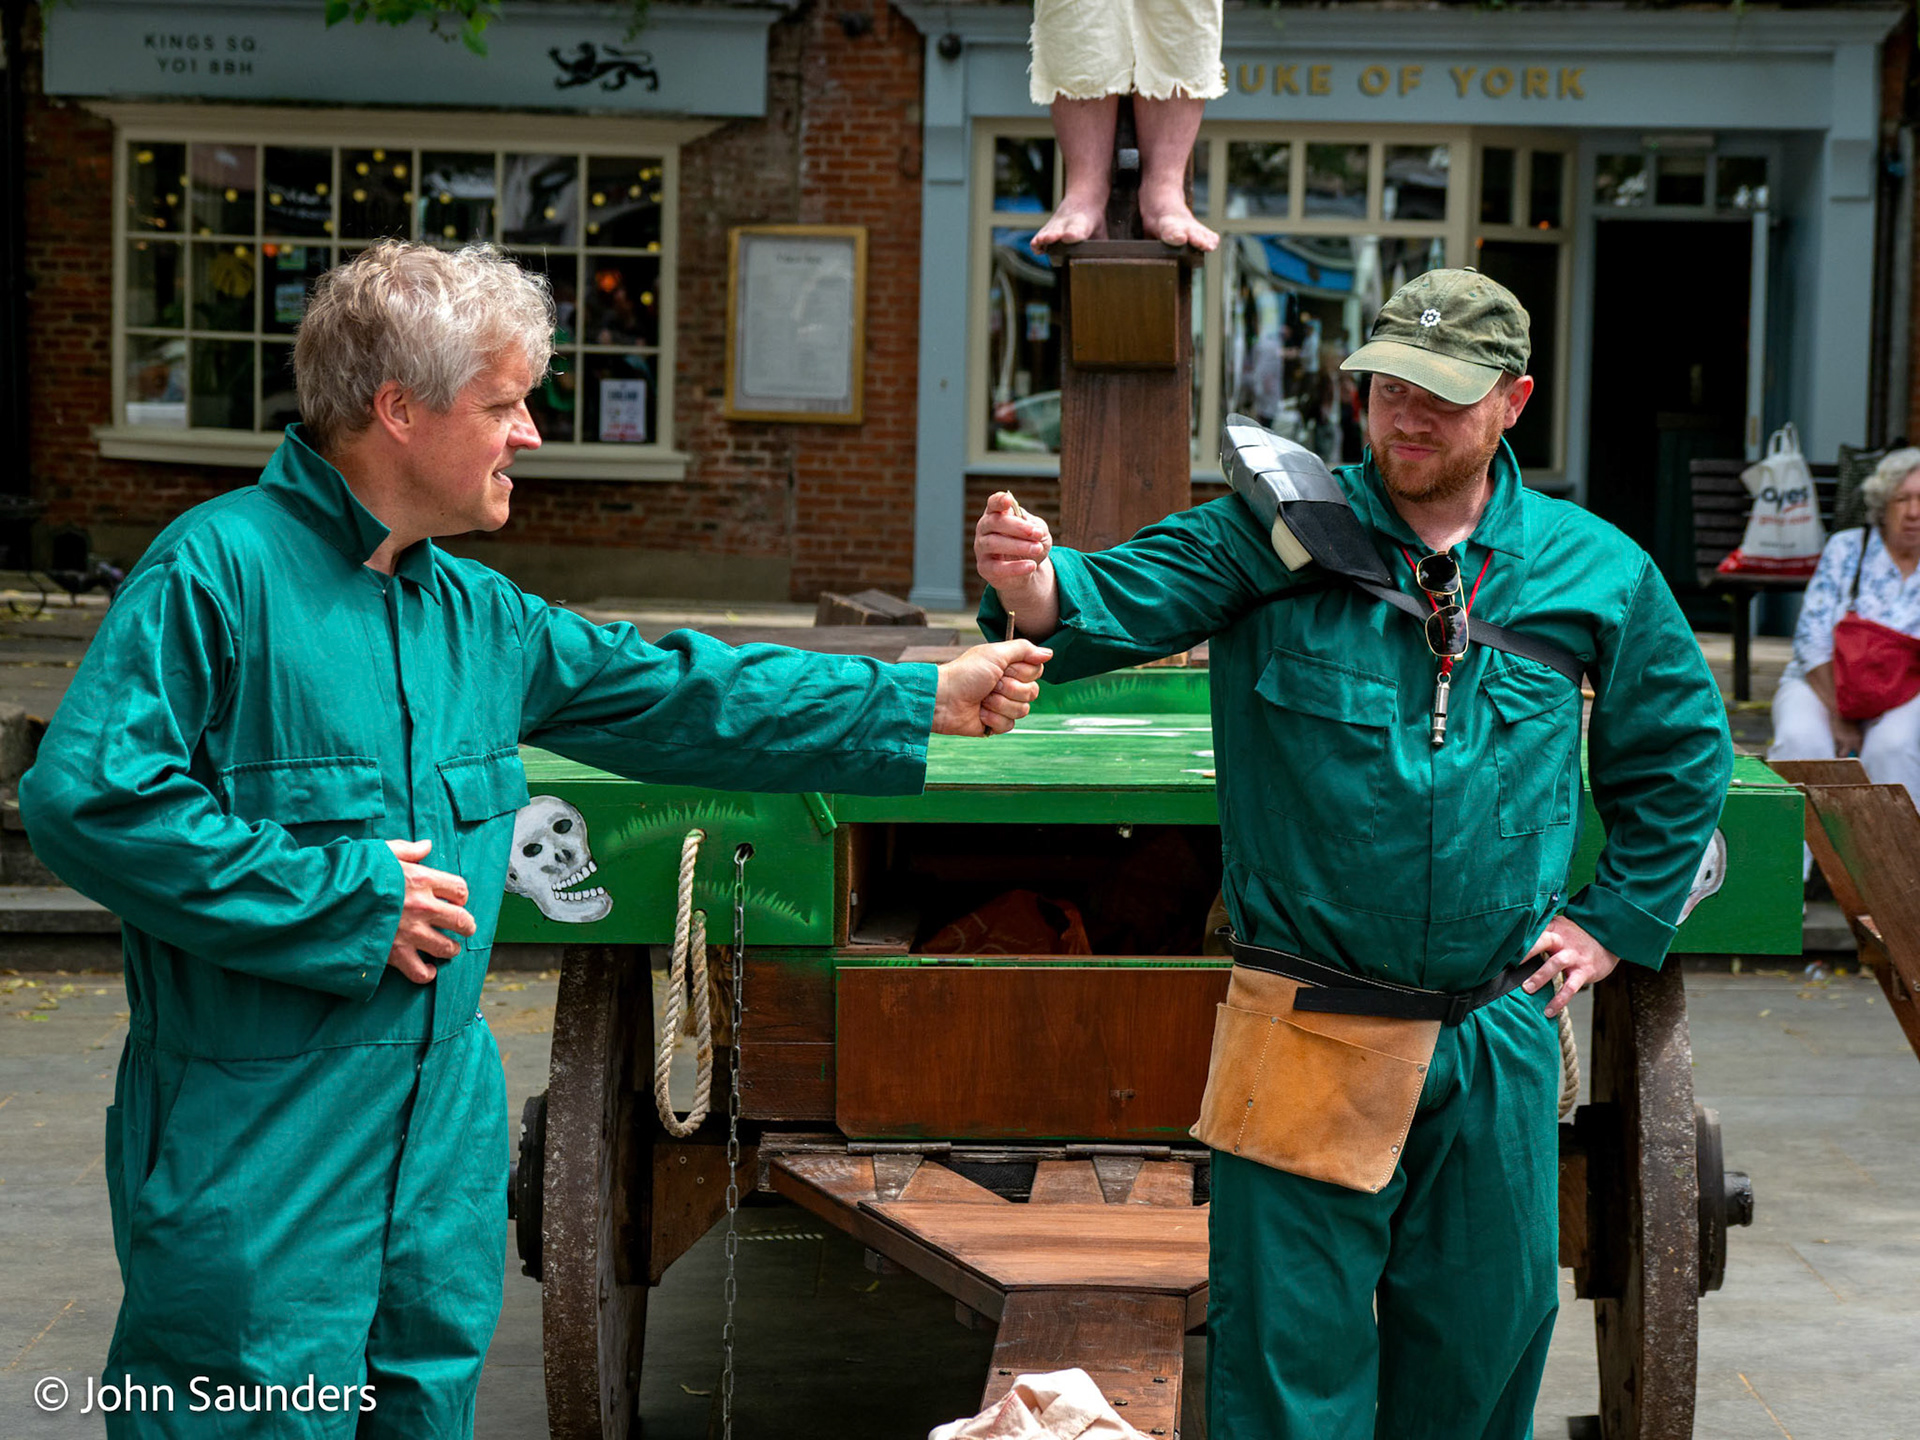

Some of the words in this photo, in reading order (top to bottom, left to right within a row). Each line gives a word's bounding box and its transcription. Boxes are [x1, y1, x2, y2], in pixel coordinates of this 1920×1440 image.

[143, 34, 215, 52] KINGS
[157, 57, 198, 74] YO1
[1221, 64, 1332, 96] UKE
[1360, 65, 1423, 97] OF
[1450, 67, 1586, 98] YORK
